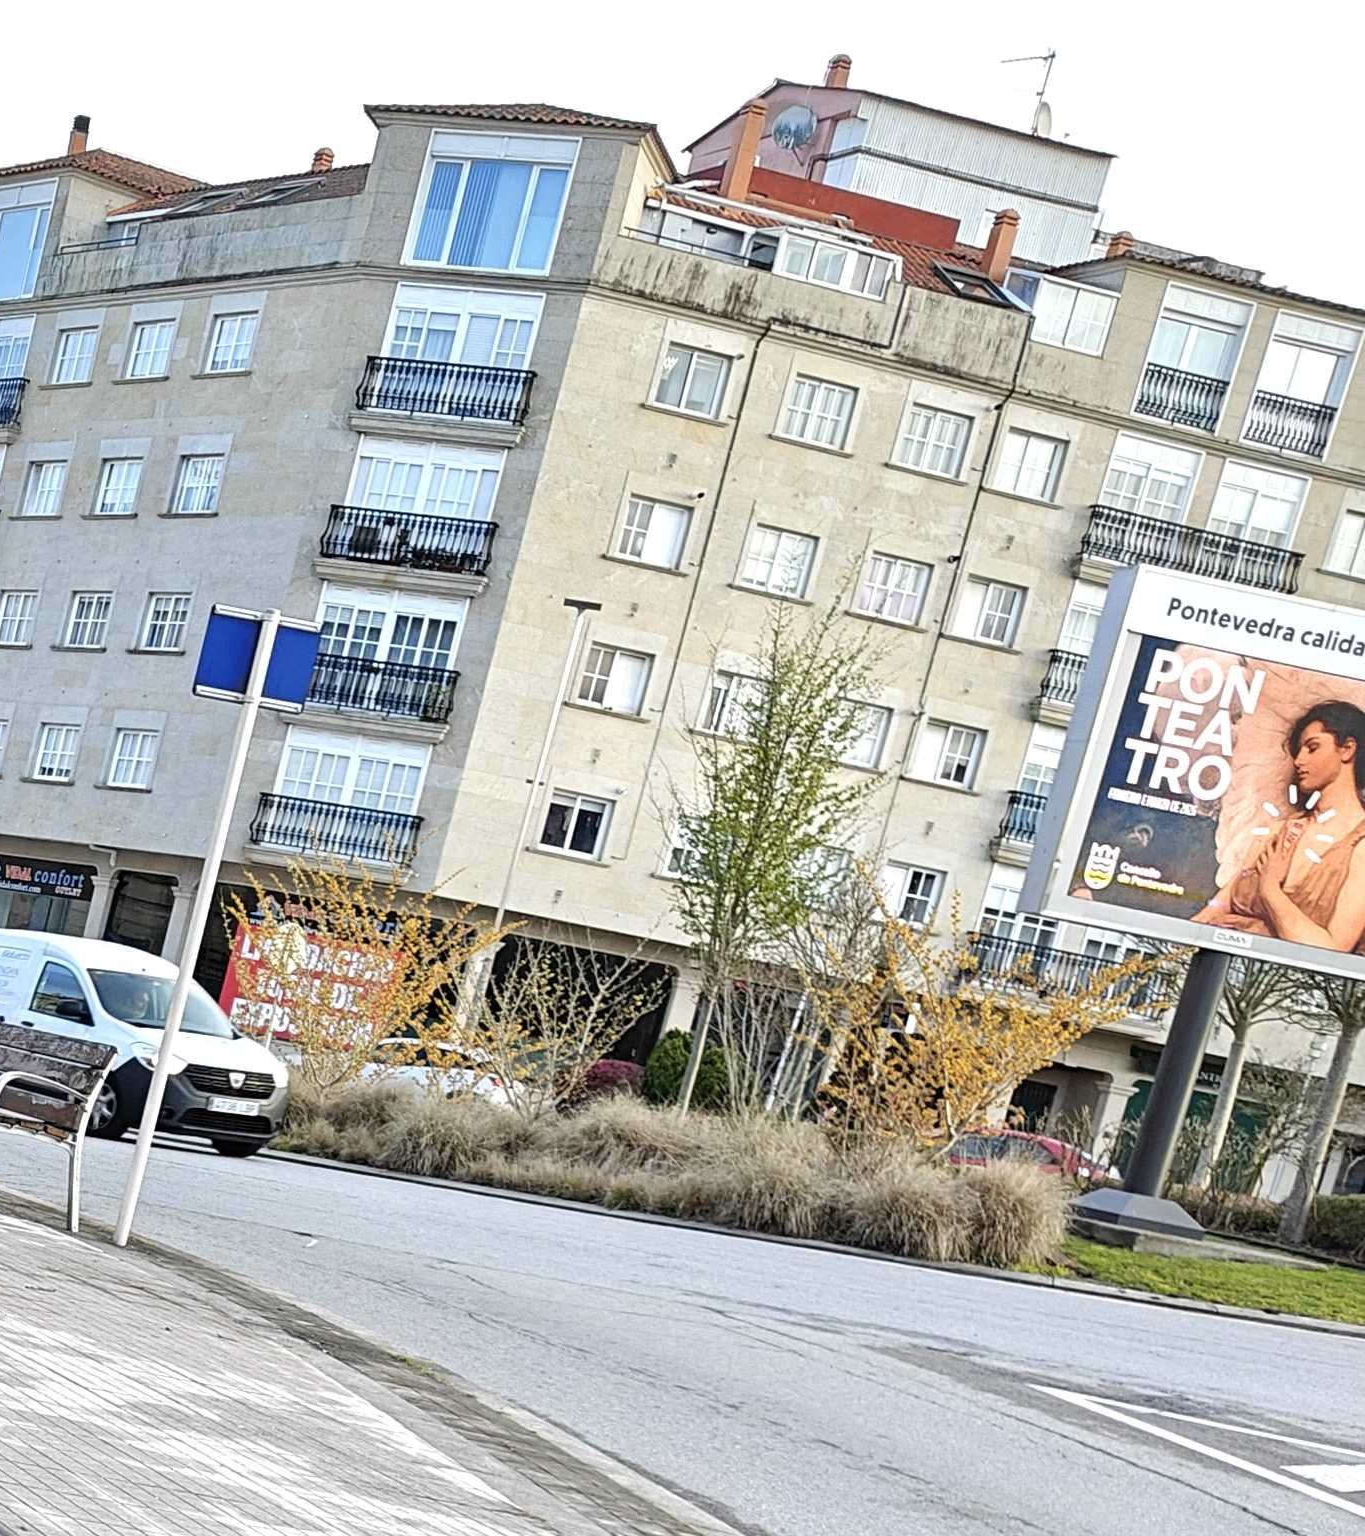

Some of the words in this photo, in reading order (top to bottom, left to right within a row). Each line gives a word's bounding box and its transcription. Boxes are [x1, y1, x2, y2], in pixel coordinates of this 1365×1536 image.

[1166, 597, 1296, 643] Pontevedra
[1143, 647, 1267, 715] PON
[1138, 692, 1234, 757] TEA
[1124, 737, 1233, 801] TRO
[34, 868, 86, 889] confort
